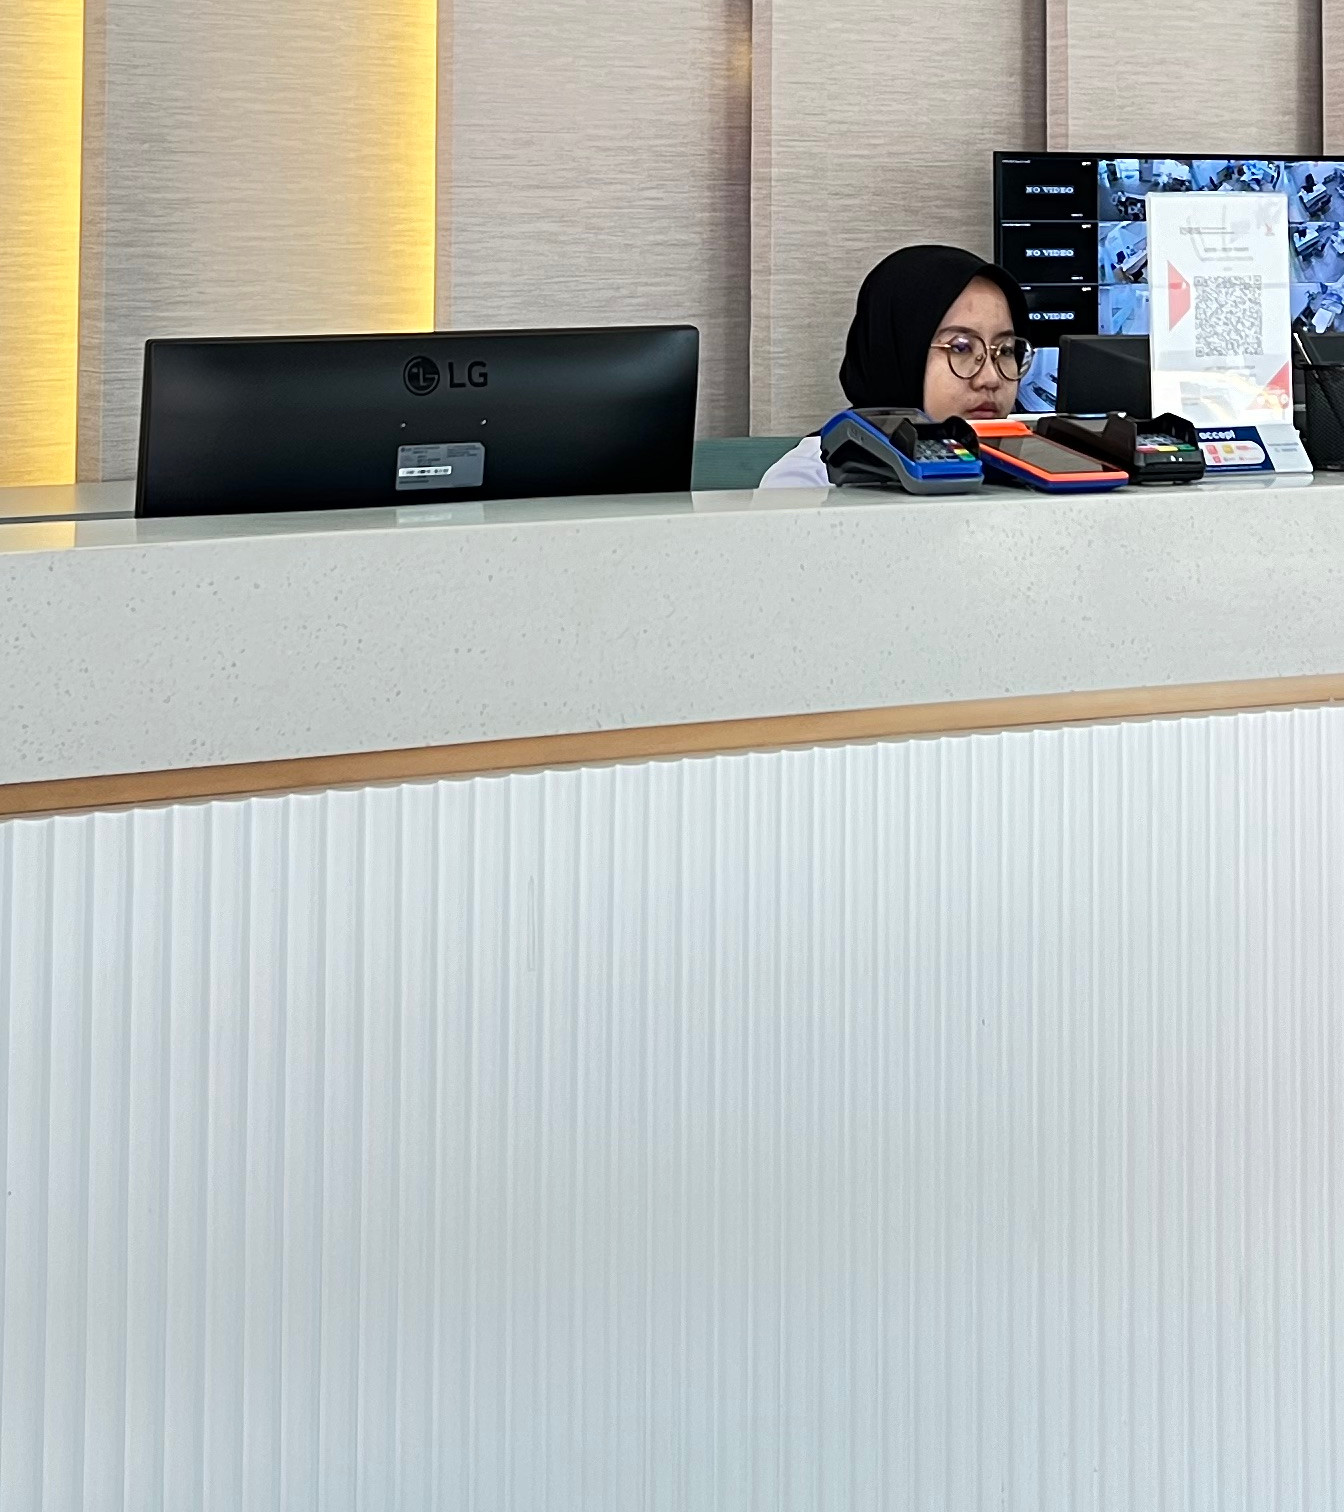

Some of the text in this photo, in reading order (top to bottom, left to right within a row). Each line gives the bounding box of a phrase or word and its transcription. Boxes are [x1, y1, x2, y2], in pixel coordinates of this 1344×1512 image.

[1025, 186, 1074, 194] NO VIDEO
[1025, 249, 1074, 257] NO VIDEO
[1043, 312, 1075, 320] VIDEO
[447, 360, 489, 389] LG
